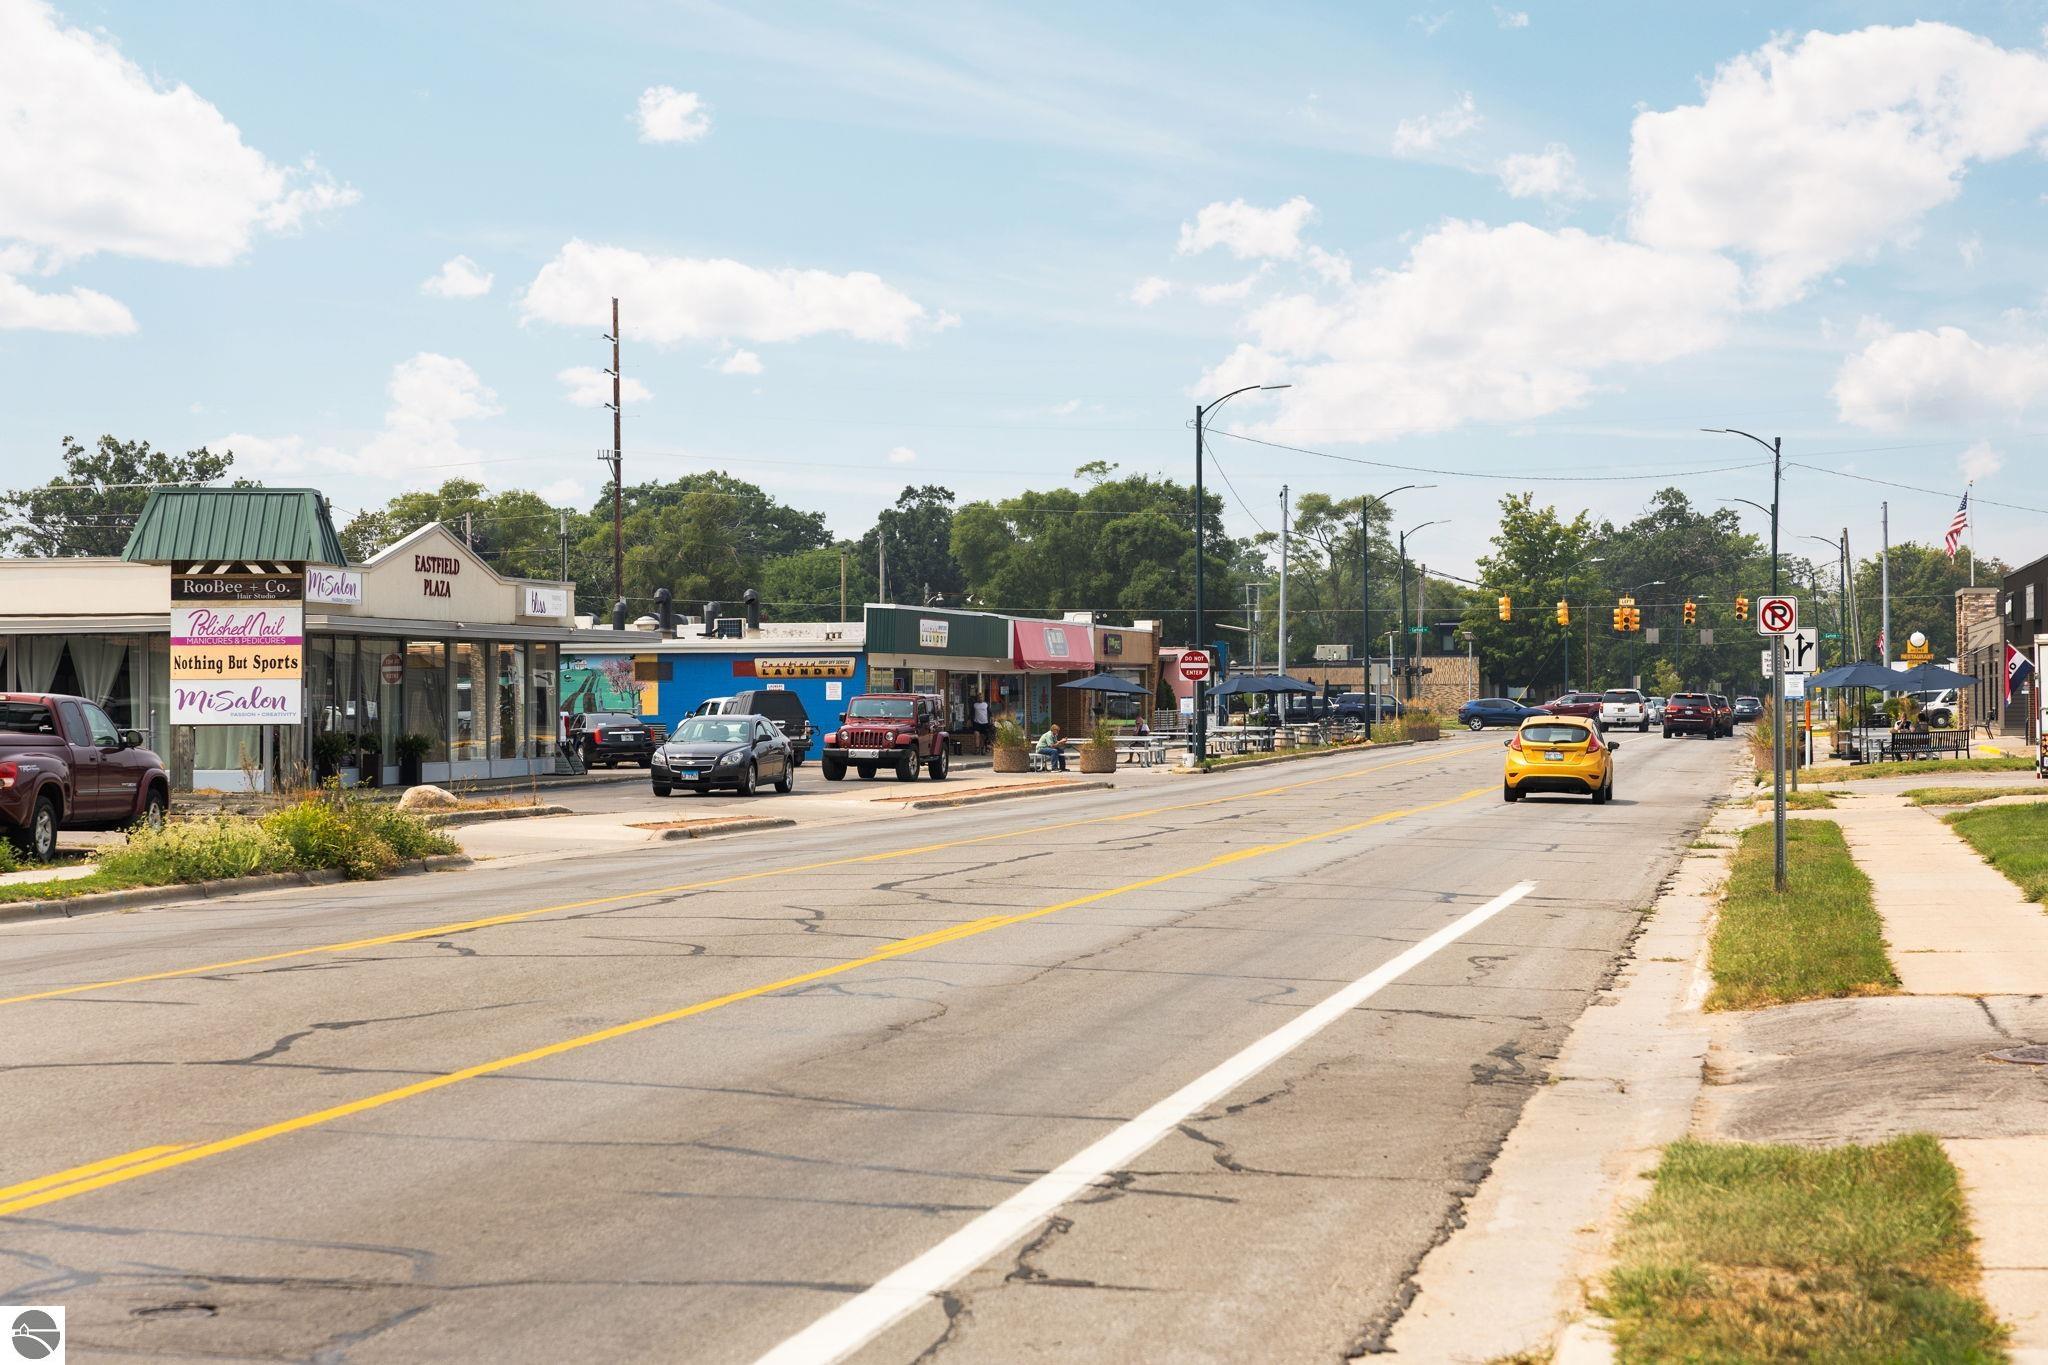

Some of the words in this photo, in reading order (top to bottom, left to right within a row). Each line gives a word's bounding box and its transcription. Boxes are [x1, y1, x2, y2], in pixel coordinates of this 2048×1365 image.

[415, 554, 460, 576] EASTFIELD
[183, 579, 243, 593] RooBee
[265, 579, 291, 593] Co.
[306, 568, 357, 598] MiSalon
[423, 578, 451, 598] PLAZA
[186, 636, 233, 645] MANICURES
[234, 636, 240, 645] &
[243, 636, 286, 645] PEDICURES
[173, 654, 223, 674] Nothing
[228, 654, 248, 670] But
[252, 654, 299, 672] Sports
[174, 685, 287, 714] MiSalon
